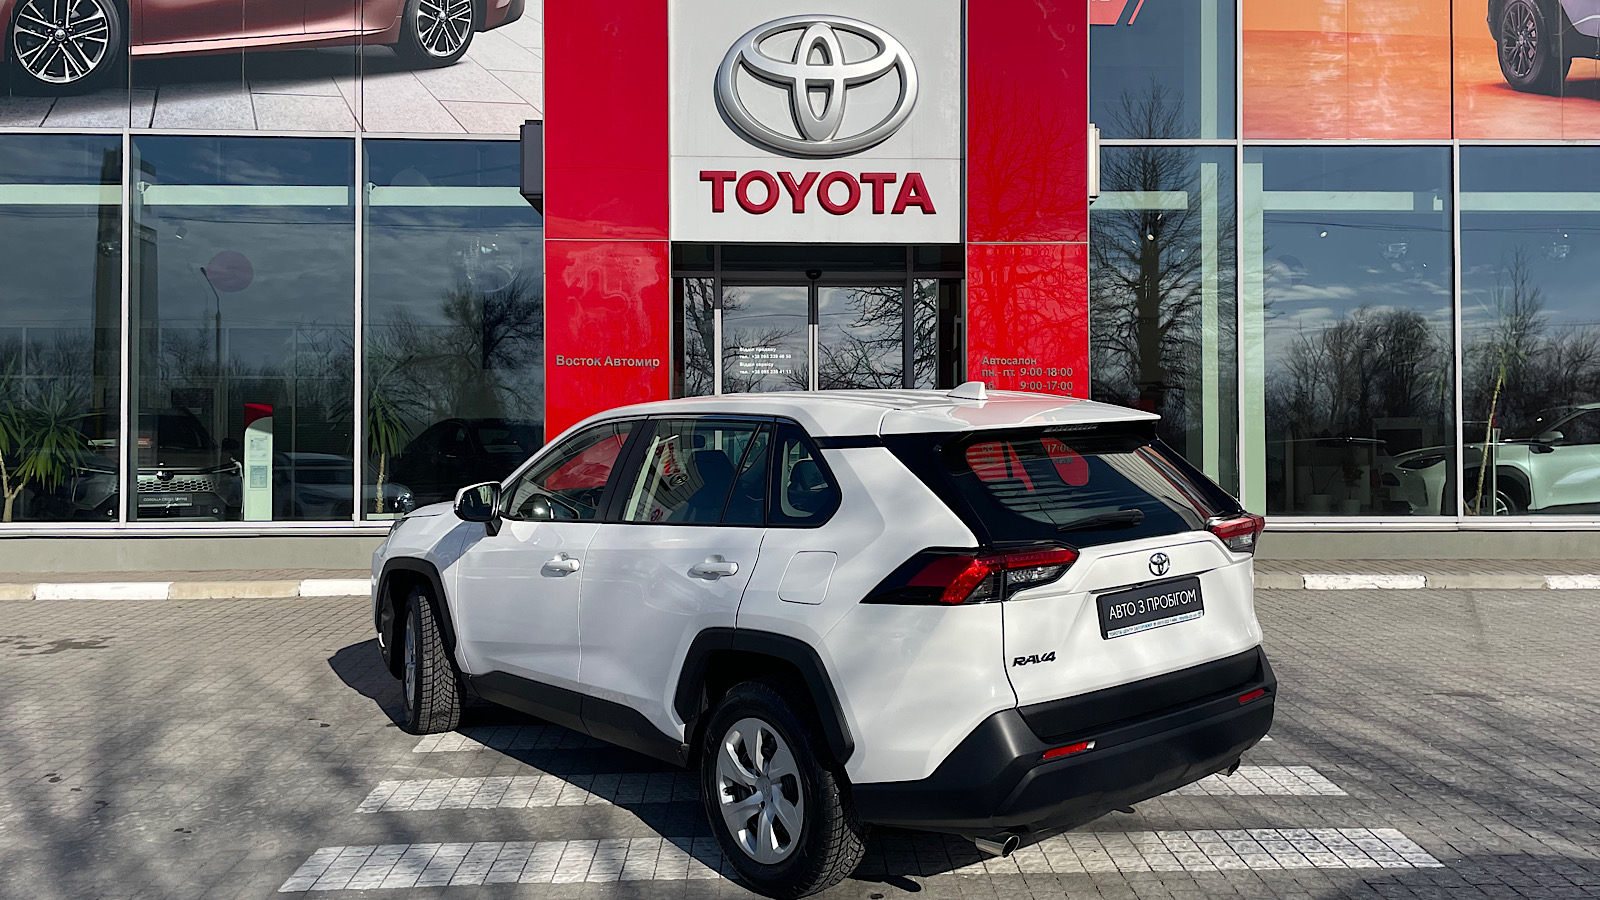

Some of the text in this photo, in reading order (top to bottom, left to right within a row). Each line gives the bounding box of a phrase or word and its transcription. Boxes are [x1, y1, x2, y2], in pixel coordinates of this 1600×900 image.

[699, 169, 937, 215] TOYOTA
[556, 354, 661, 370] Восток Автомир
[982, 356, 1037, 365] Автосалон
[1020, 381, 1073, 391] 9:00-17:00
[1109, 601, 1136, 620] АВТО
[1146, 588, 1197, 612] ПРОБІГОМ
[1012, 651, 1057, 667] RAV4
